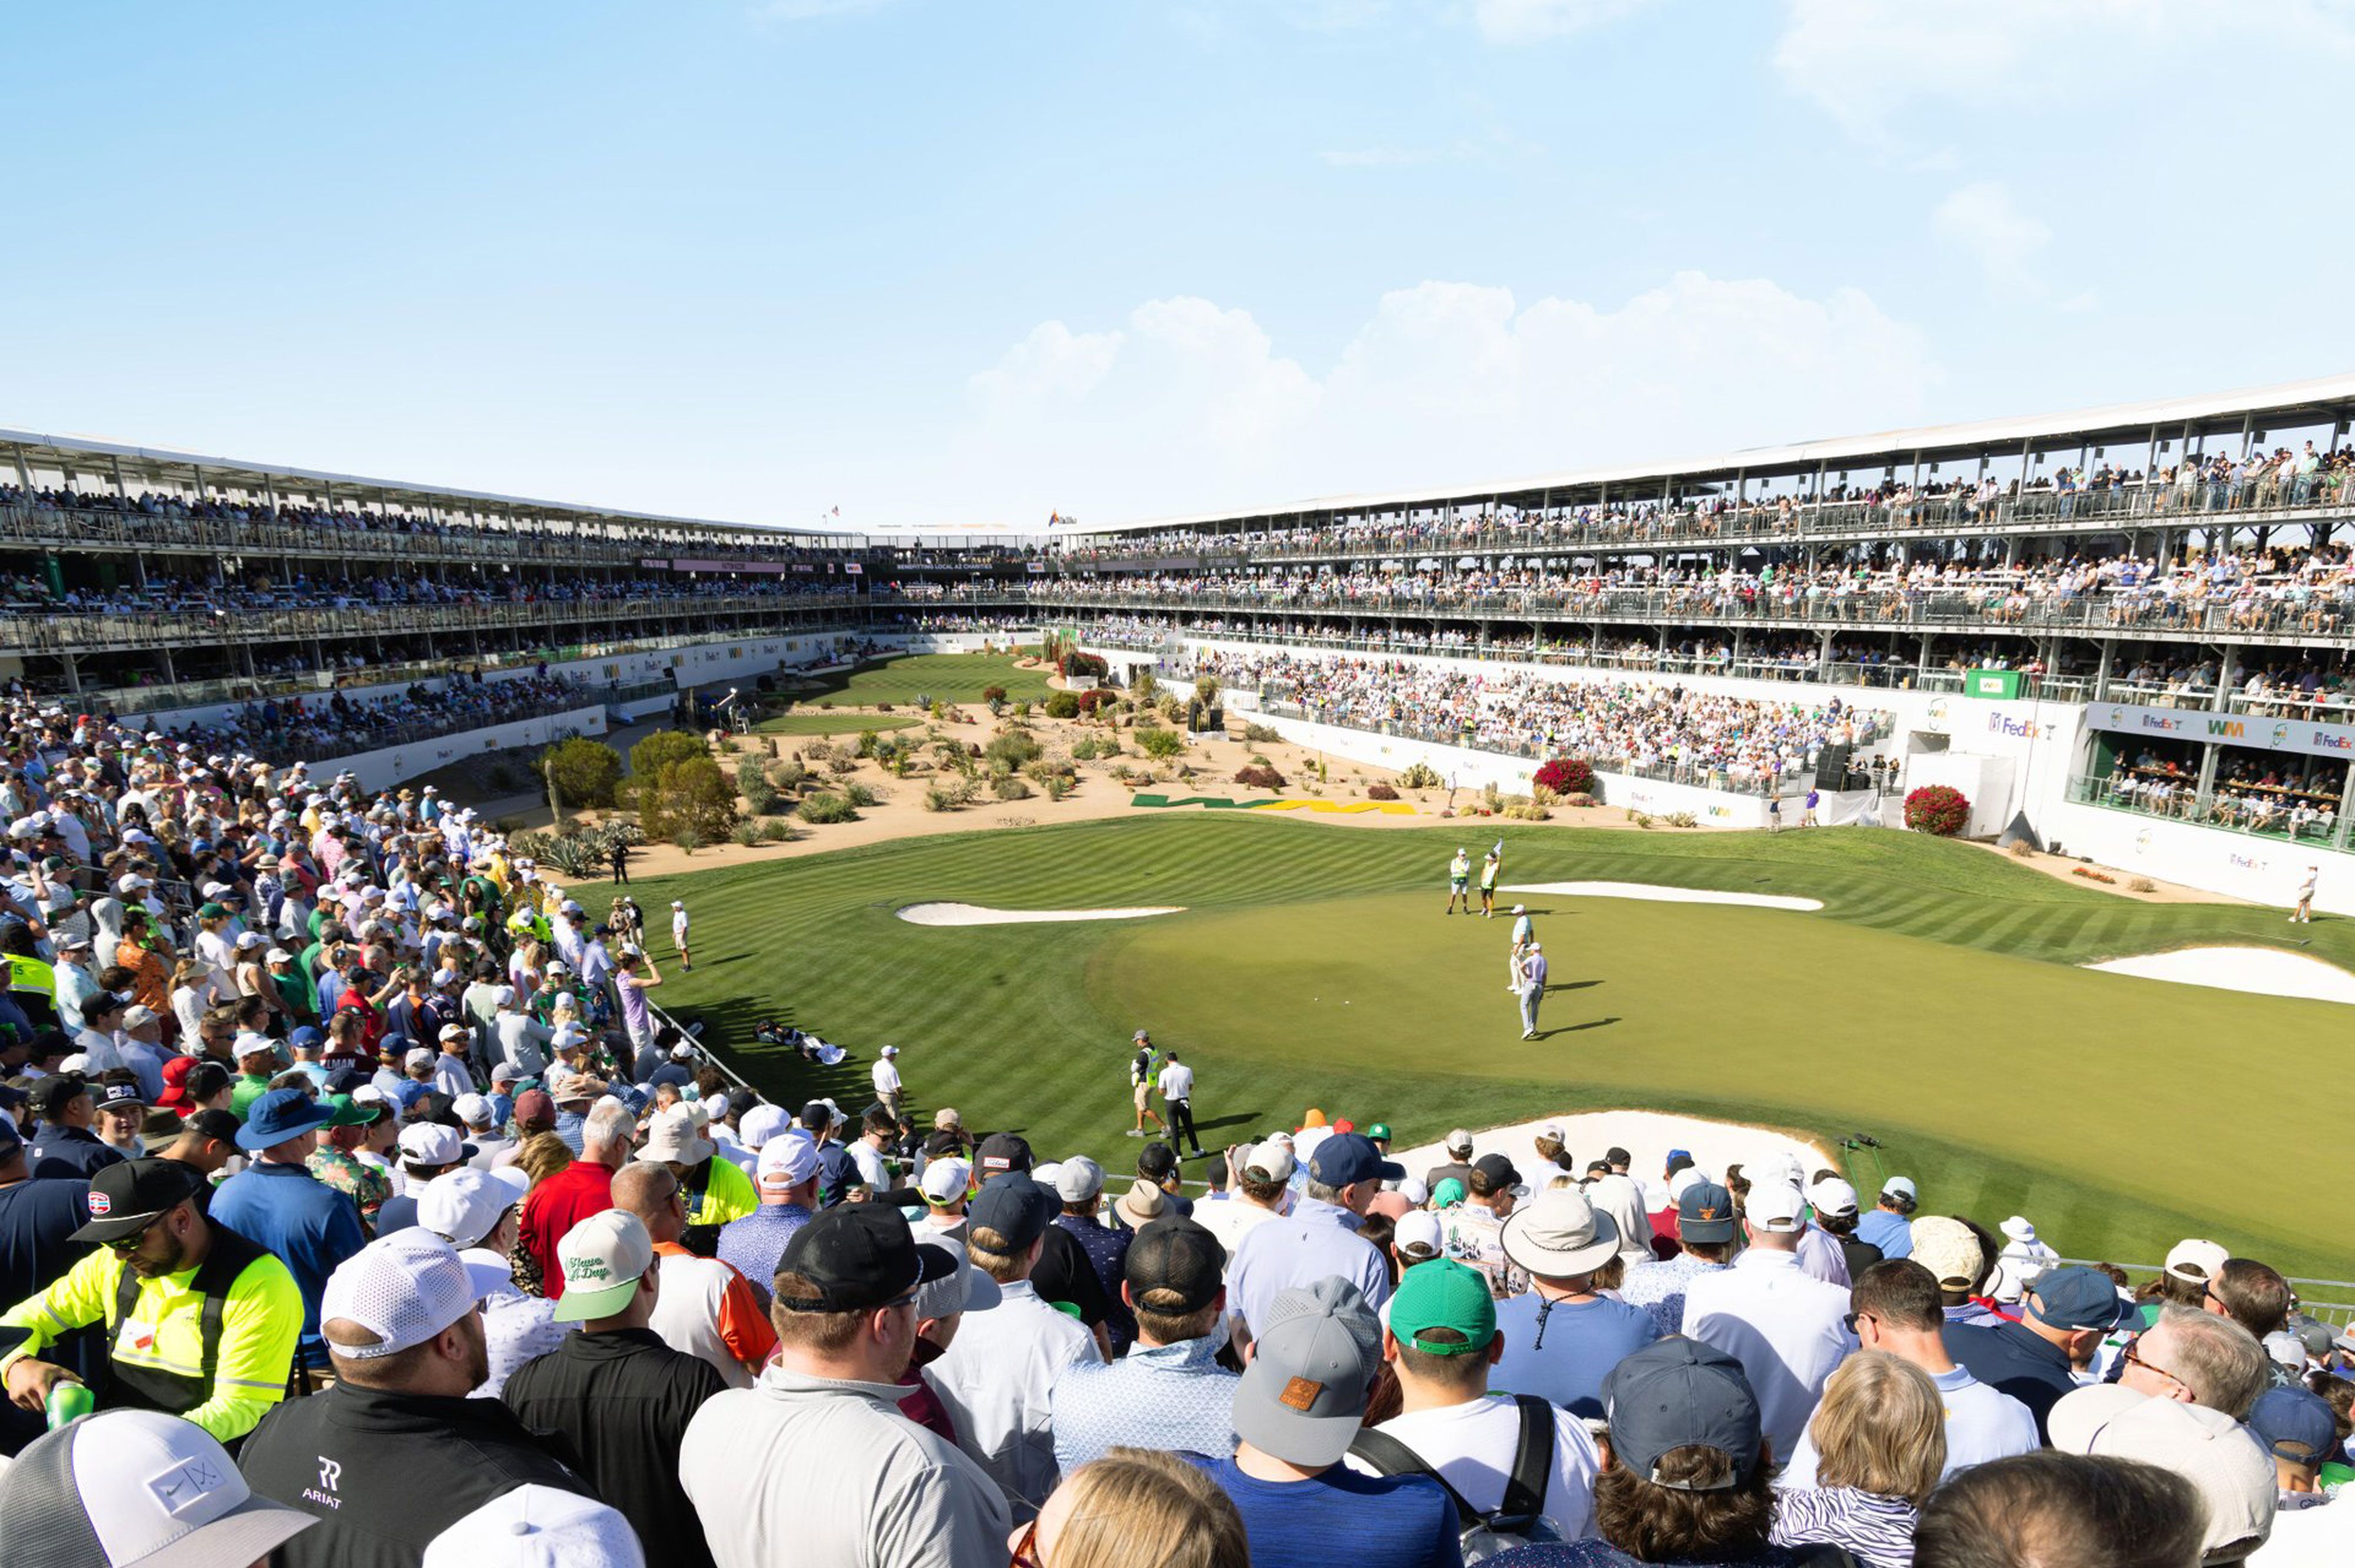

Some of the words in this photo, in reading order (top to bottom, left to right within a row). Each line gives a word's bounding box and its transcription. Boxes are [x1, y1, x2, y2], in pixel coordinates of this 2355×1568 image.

[2002, 717, 2040, 738] FedEx
[2150, 717, 2173, 730] FedEx
[2208, 720, 2245, 738] WM
[2323, 735, 2352, 749] FedEx
[1709, 805, 1731, 818] WM
[302, 1487, 341, 1510] ARIAT
